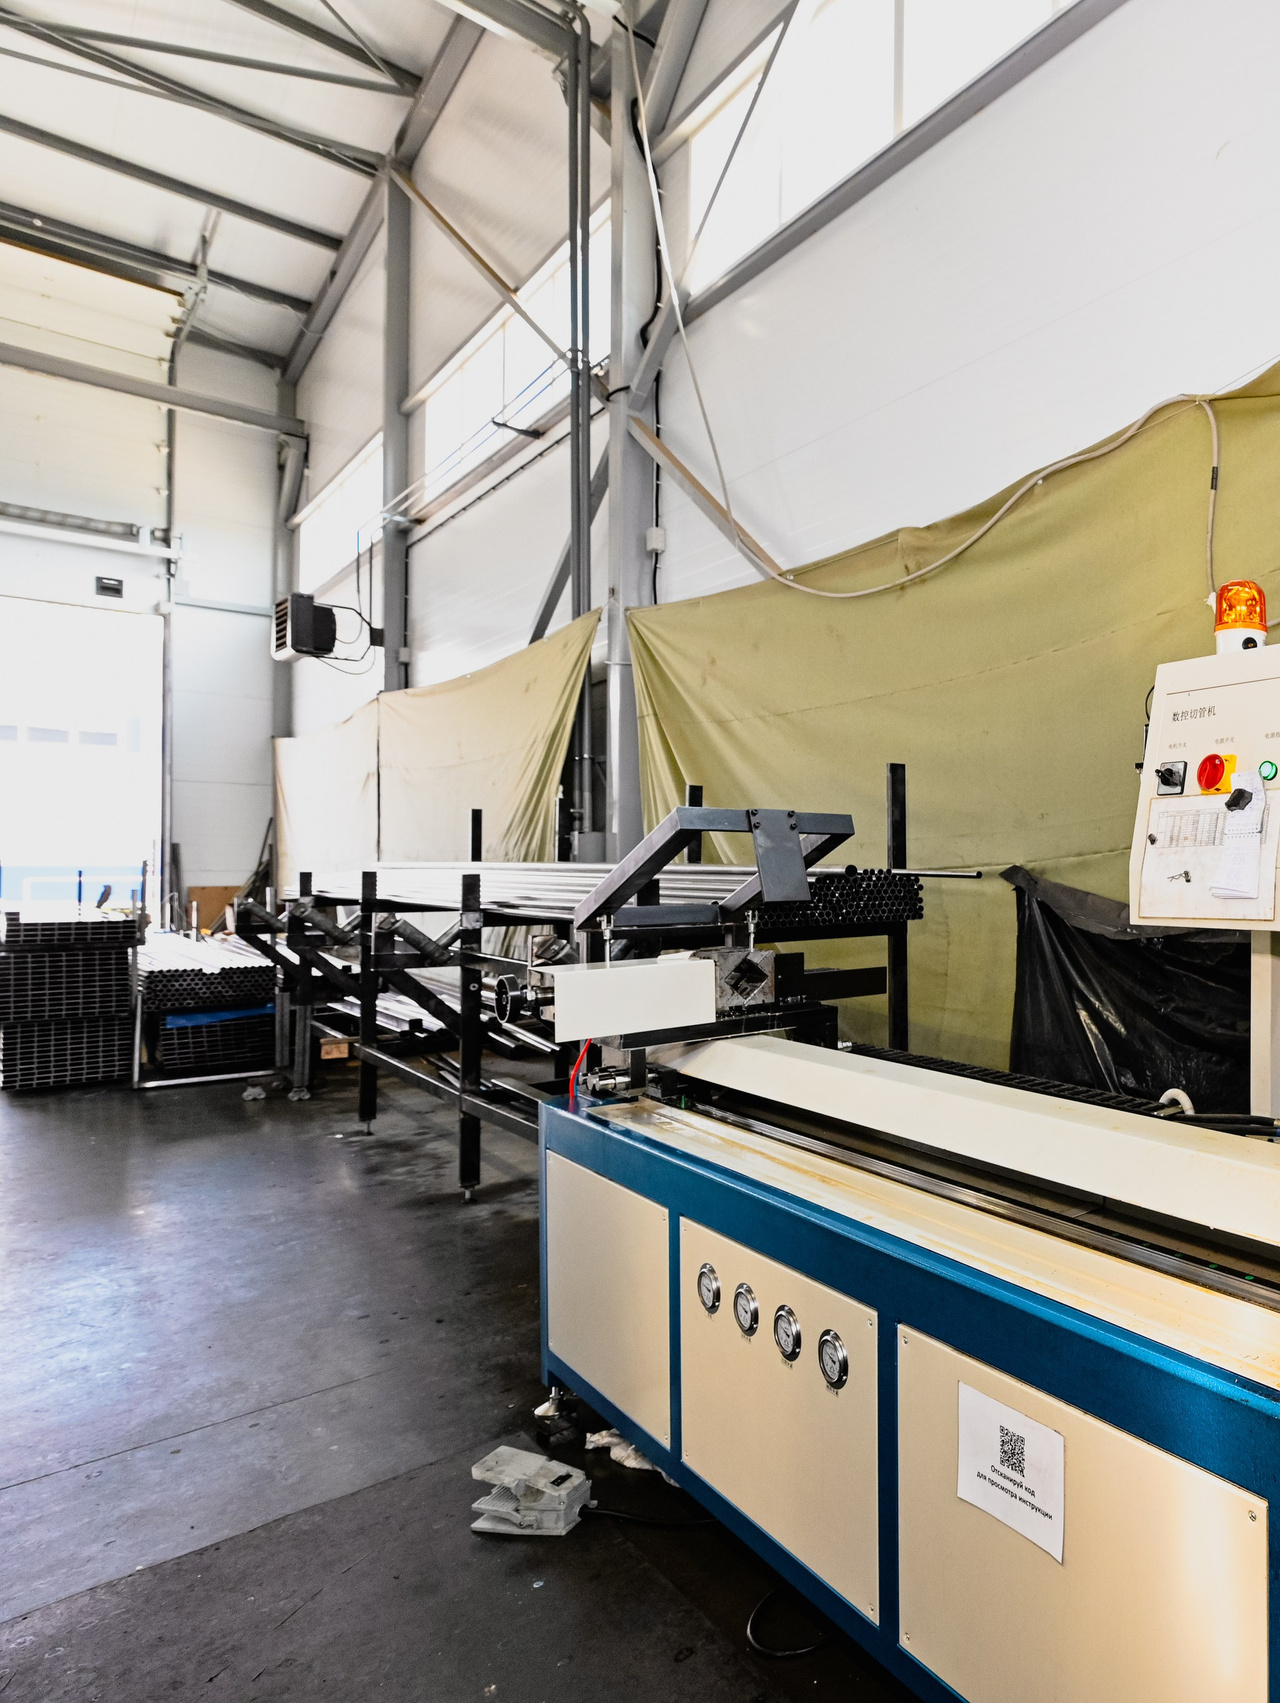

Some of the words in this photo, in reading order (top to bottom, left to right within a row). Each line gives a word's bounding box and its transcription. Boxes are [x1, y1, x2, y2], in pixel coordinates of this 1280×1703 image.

[1171, 705, 1217, 722] 数控切管机
[976, 1471, 987, 1482] для
[988, 1478, 1018, 1500] просмотра
[1018, 1496, 1053, 1521] инструкции
[991, 1465, 1023, 1489] Отсканируй
[1024, 1485, 1036, 1498] код
